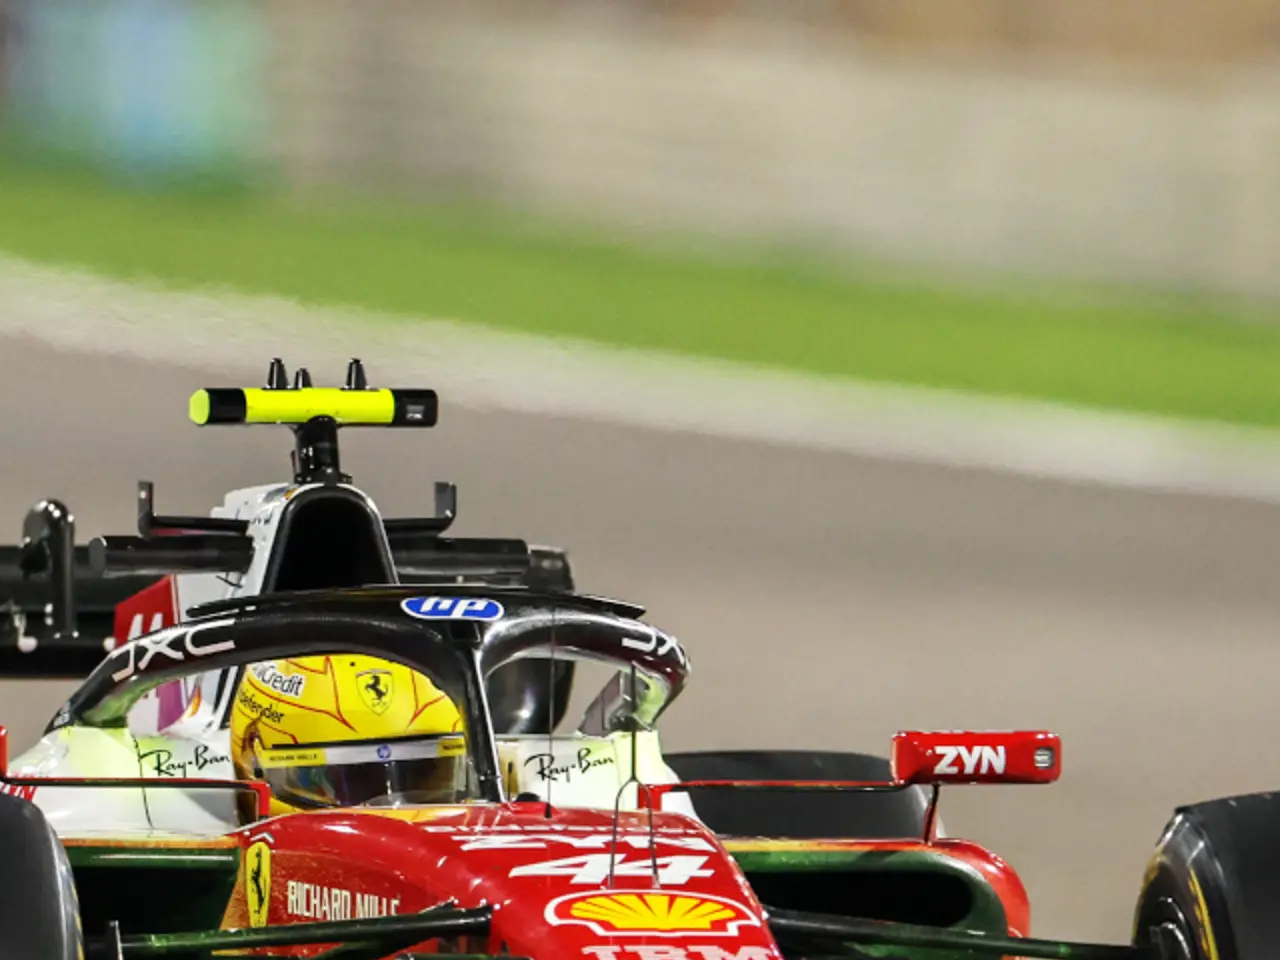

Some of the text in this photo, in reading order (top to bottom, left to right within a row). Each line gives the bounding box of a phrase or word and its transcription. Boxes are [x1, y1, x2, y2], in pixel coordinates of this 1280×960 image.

[415, 597, 492, 620] hp
[139, 744, 231, 779] Ray-Ban
[524, 748, 615, 781] Ray-Ban
[933, 746, 1006, 774] ZYN
[509, 853, 716, 884] 44
[287, 880, 352, 921] RICHARD
